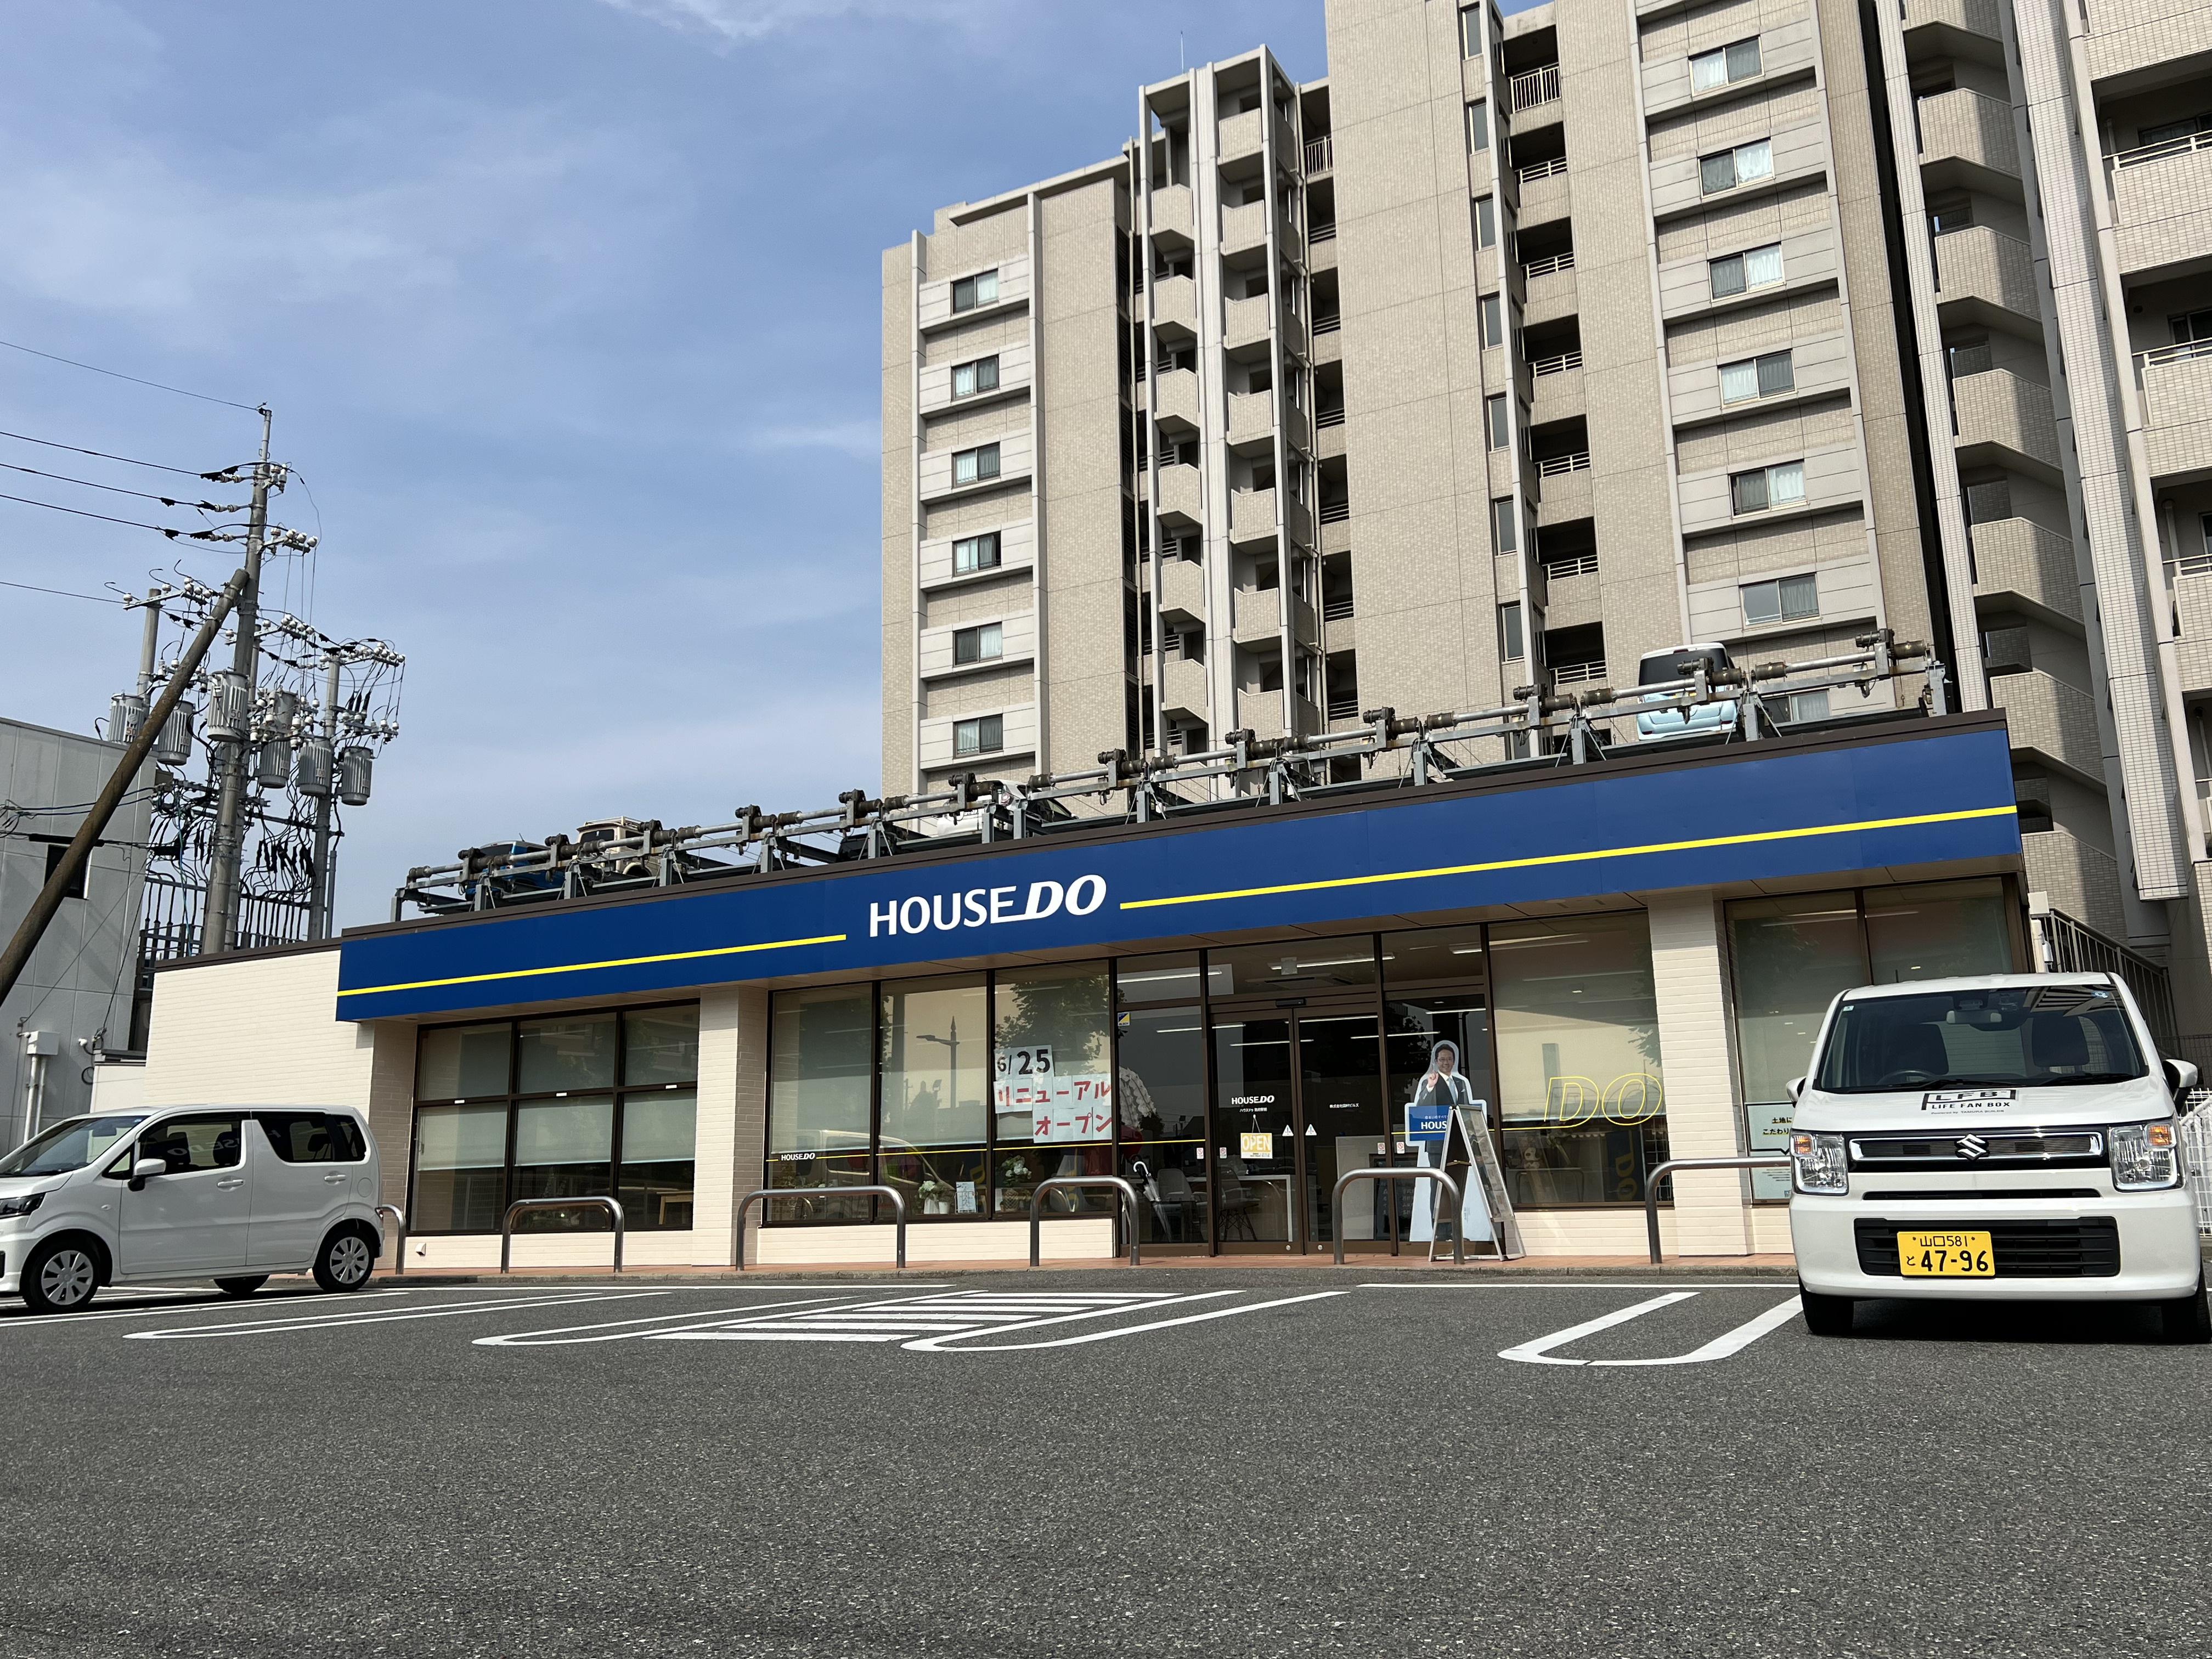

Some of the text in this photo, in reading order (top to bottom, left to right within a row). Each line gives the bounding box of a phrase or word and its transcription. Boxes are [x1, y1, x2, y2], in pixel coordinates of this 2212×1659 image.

[231, 709, 241, 718] 50
[997, 1048, 1051, 1075] 6/25
[998, 1081, 1111, 1107] リニューアル
[1544, 1073, 1662, 1125] DO
[1034, 1113, 1113, 1136] オープン
[1242, 1135, 1271, 1151] OPEN
[1906, 1250, 1989, 1272] と 47-96
